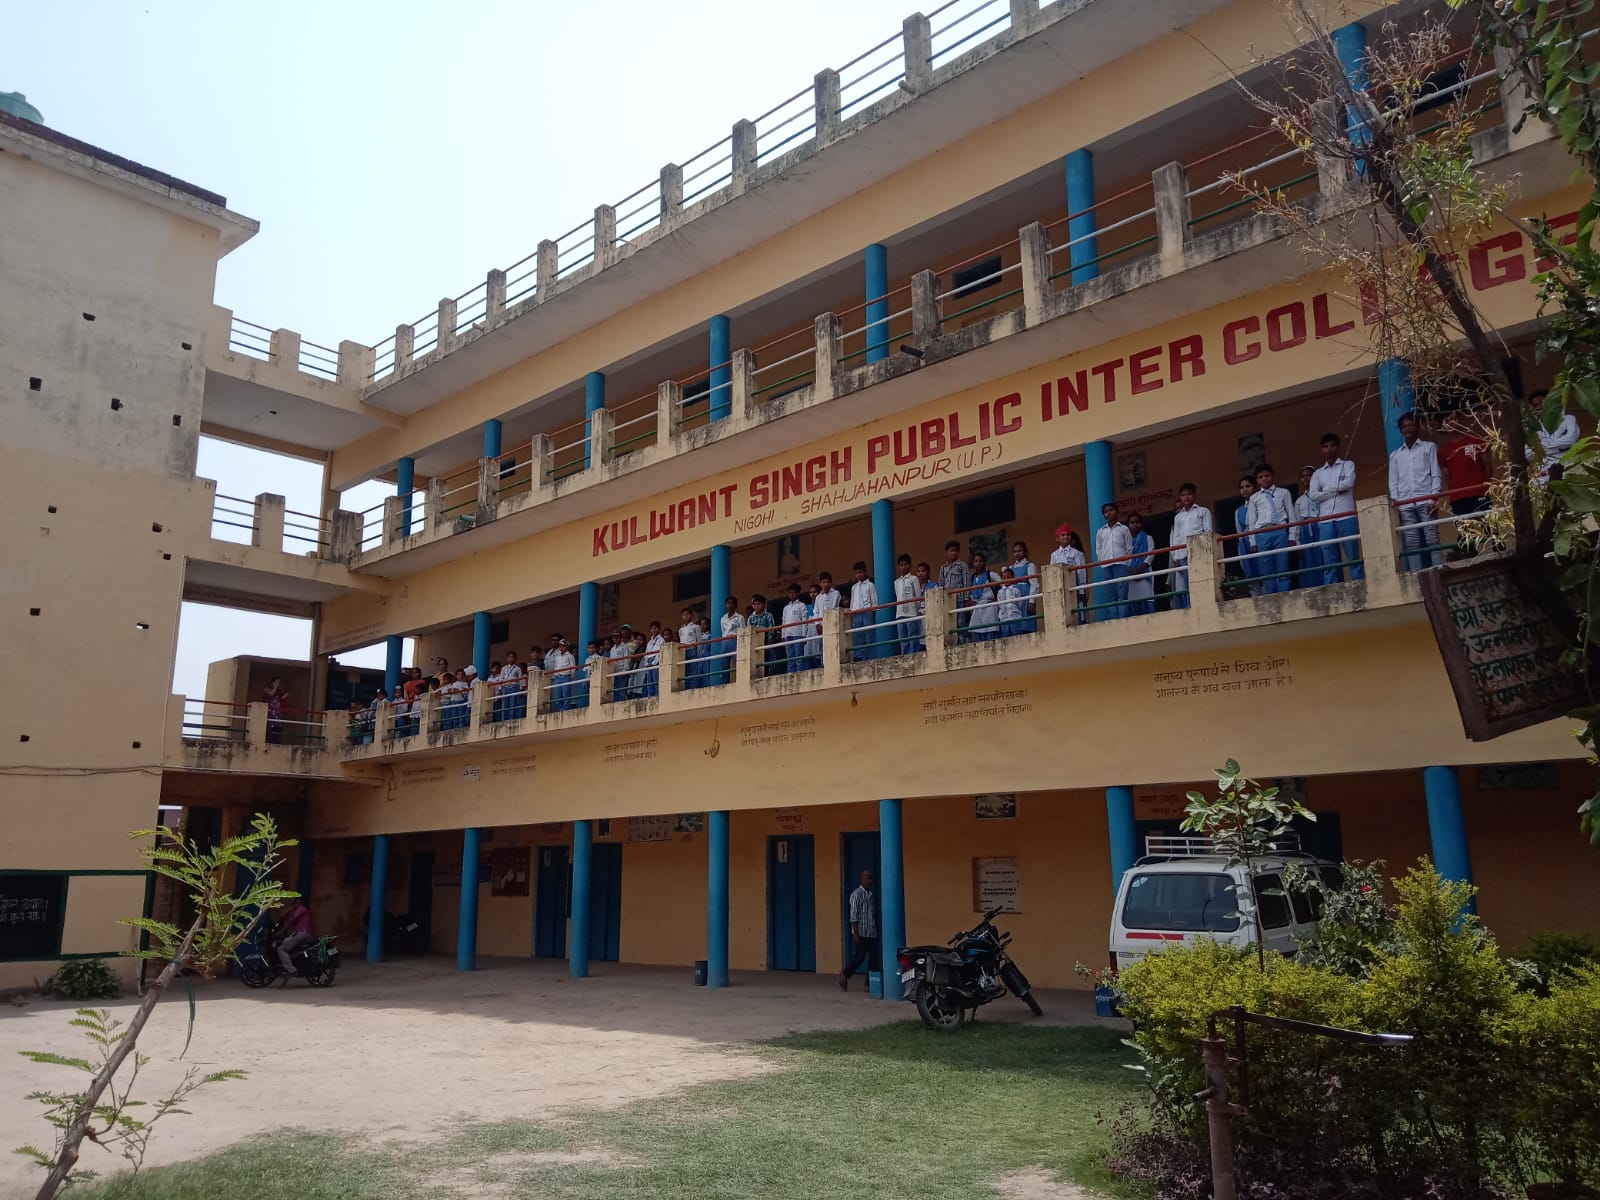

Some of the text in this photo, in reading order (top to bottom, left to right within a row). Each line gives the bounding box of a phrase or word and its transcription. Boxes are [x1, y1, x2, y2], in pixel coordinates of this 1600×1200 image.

[592, 485, 738, 557] KULWANT
[749, 446, 852, 510] SINGH
[867, 392, 1022, 474] PUBLIC
[1041, 333, 1206, 422] INTER
[734, 509, 775, 534] NIGOHI
[801, 458, 952, 515] SHAHJAHANPUR
